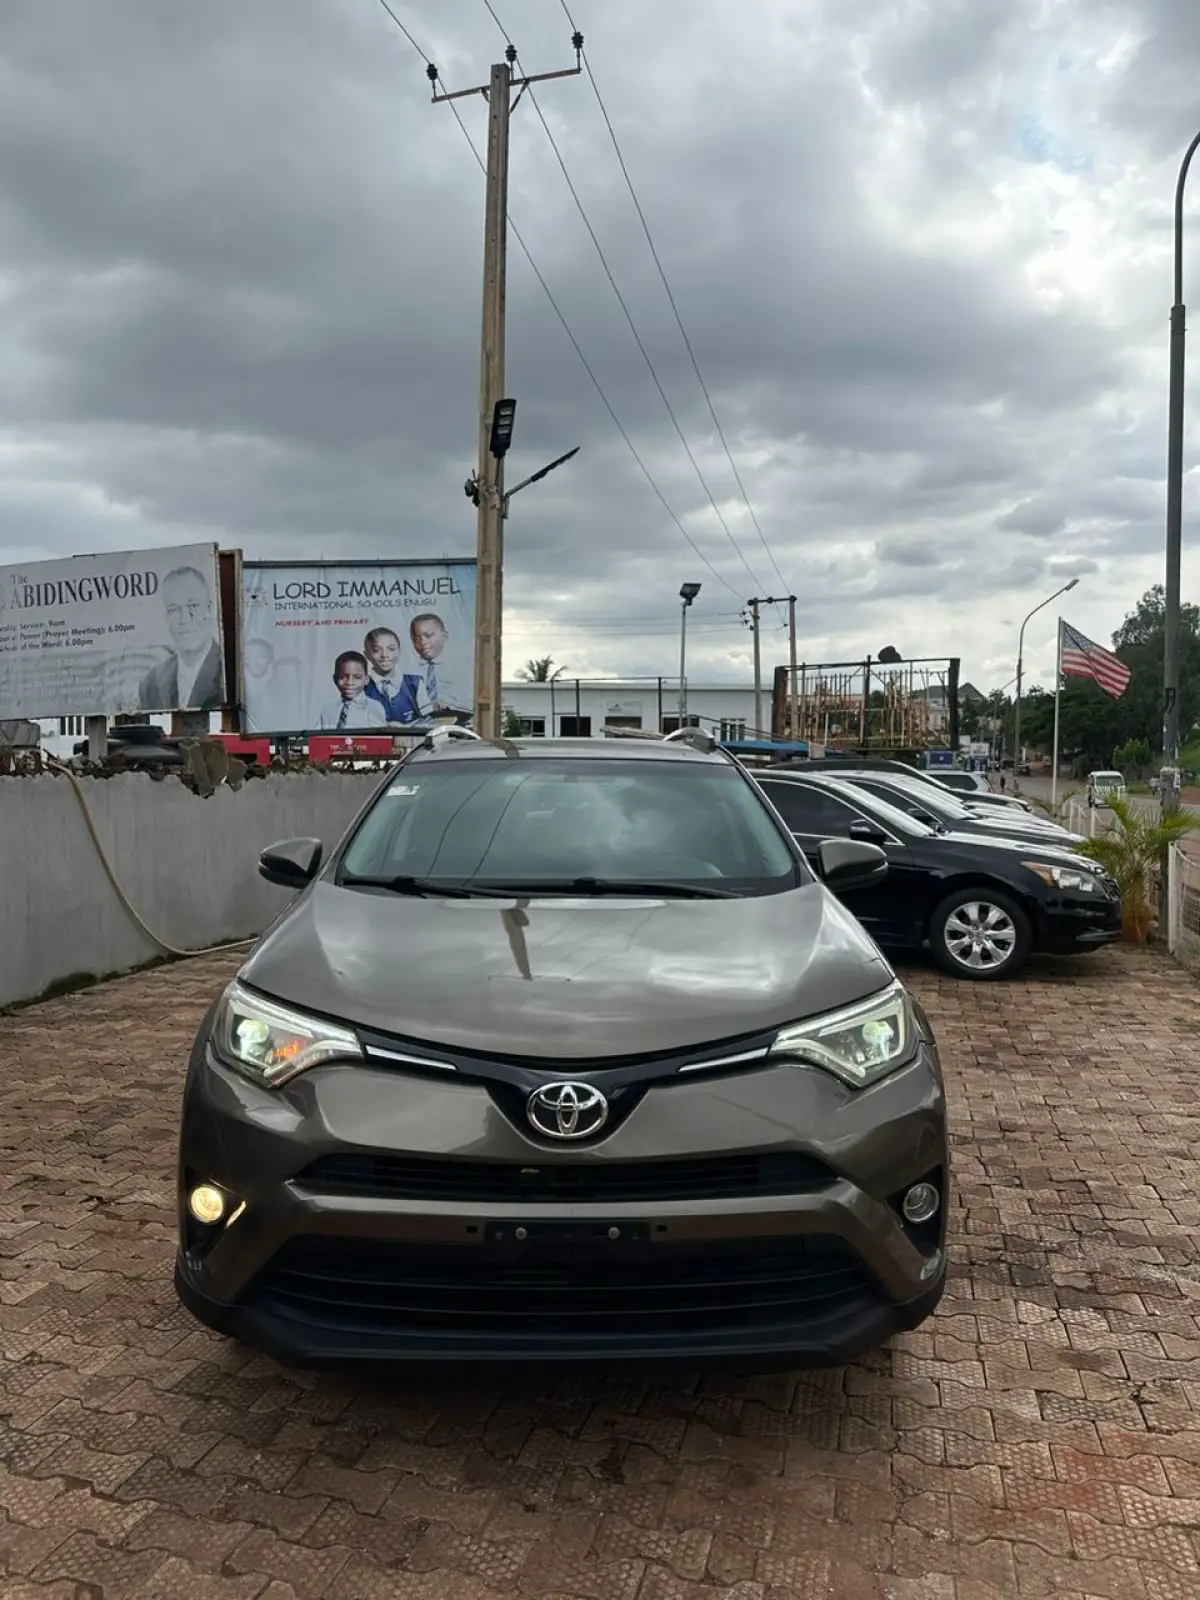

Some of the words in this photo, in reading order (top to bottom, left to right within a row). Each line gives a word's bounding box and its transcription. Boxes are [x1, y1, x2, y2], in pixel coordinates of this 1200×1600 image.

[10, 571, 158, 609] ABIDINGWORD
[273, 582, 330, 600] LORD
[337, 577, 461, 598] IMMANUEL
[274, 600, 354, 611] INTERNATIONAL
[358, 599, 400, 610] SCHOOLS
[404, 598, 437, 608] ENUGU
[274, 618, 312, 628] NURSERY
[314, 617, 332, 626] AND
[333, 616, 370, 626] PRIMARY
